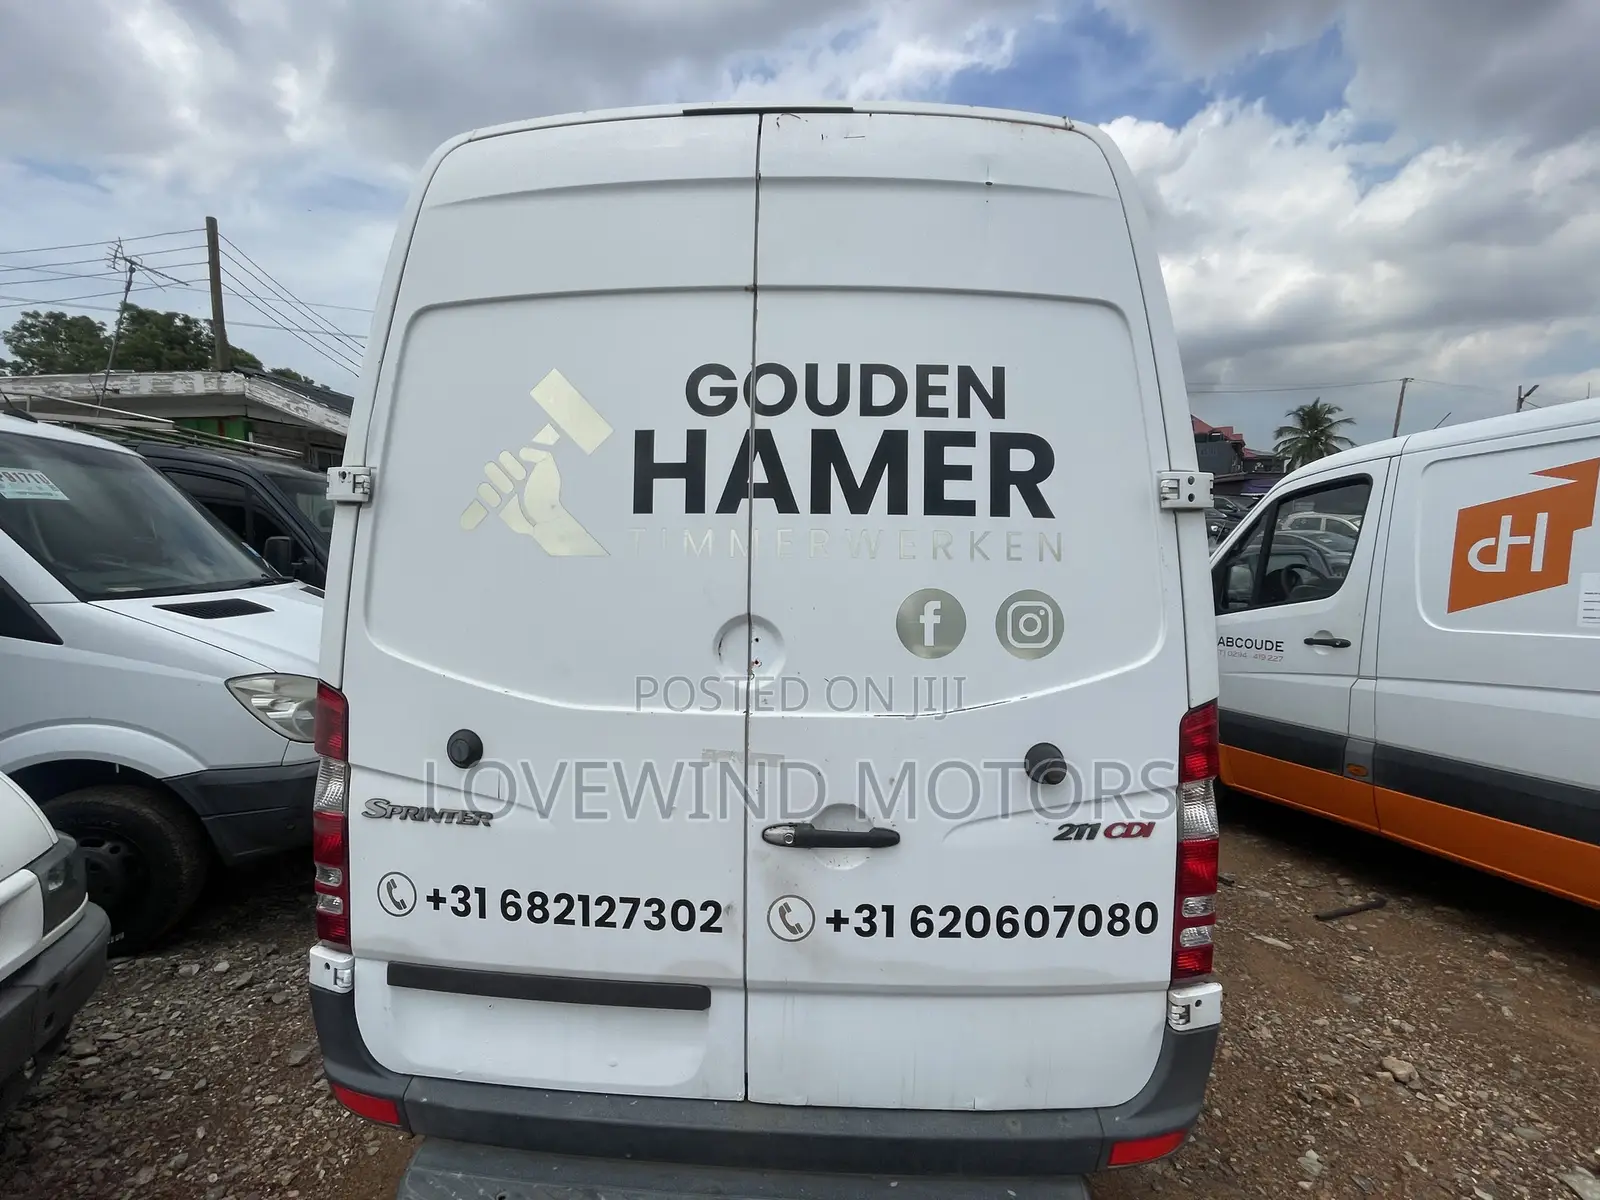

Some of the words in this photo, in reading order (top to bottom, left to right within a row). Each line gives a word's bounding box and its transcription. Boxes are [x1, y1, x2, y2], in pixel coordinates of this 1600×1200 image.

[685, 362, 1006, 419] GOUDEN
[633, 429, 1056, 519] HAMER
[629, 528, 1063, 563] TIMMERWERKEN
[1217, 636, 1284, 652] ABCOUDE
[1267, 654, 1284, 662] 227
[1053, 823, 1101, 841] 211
[1104, 822, 1156, 839] CDI
[426, 885, 487, 919] +31
[500, 889, 723, 933] 682127302
[825, 904, 895, 938] +31
[910, 901, 1159, 939] 620607080
